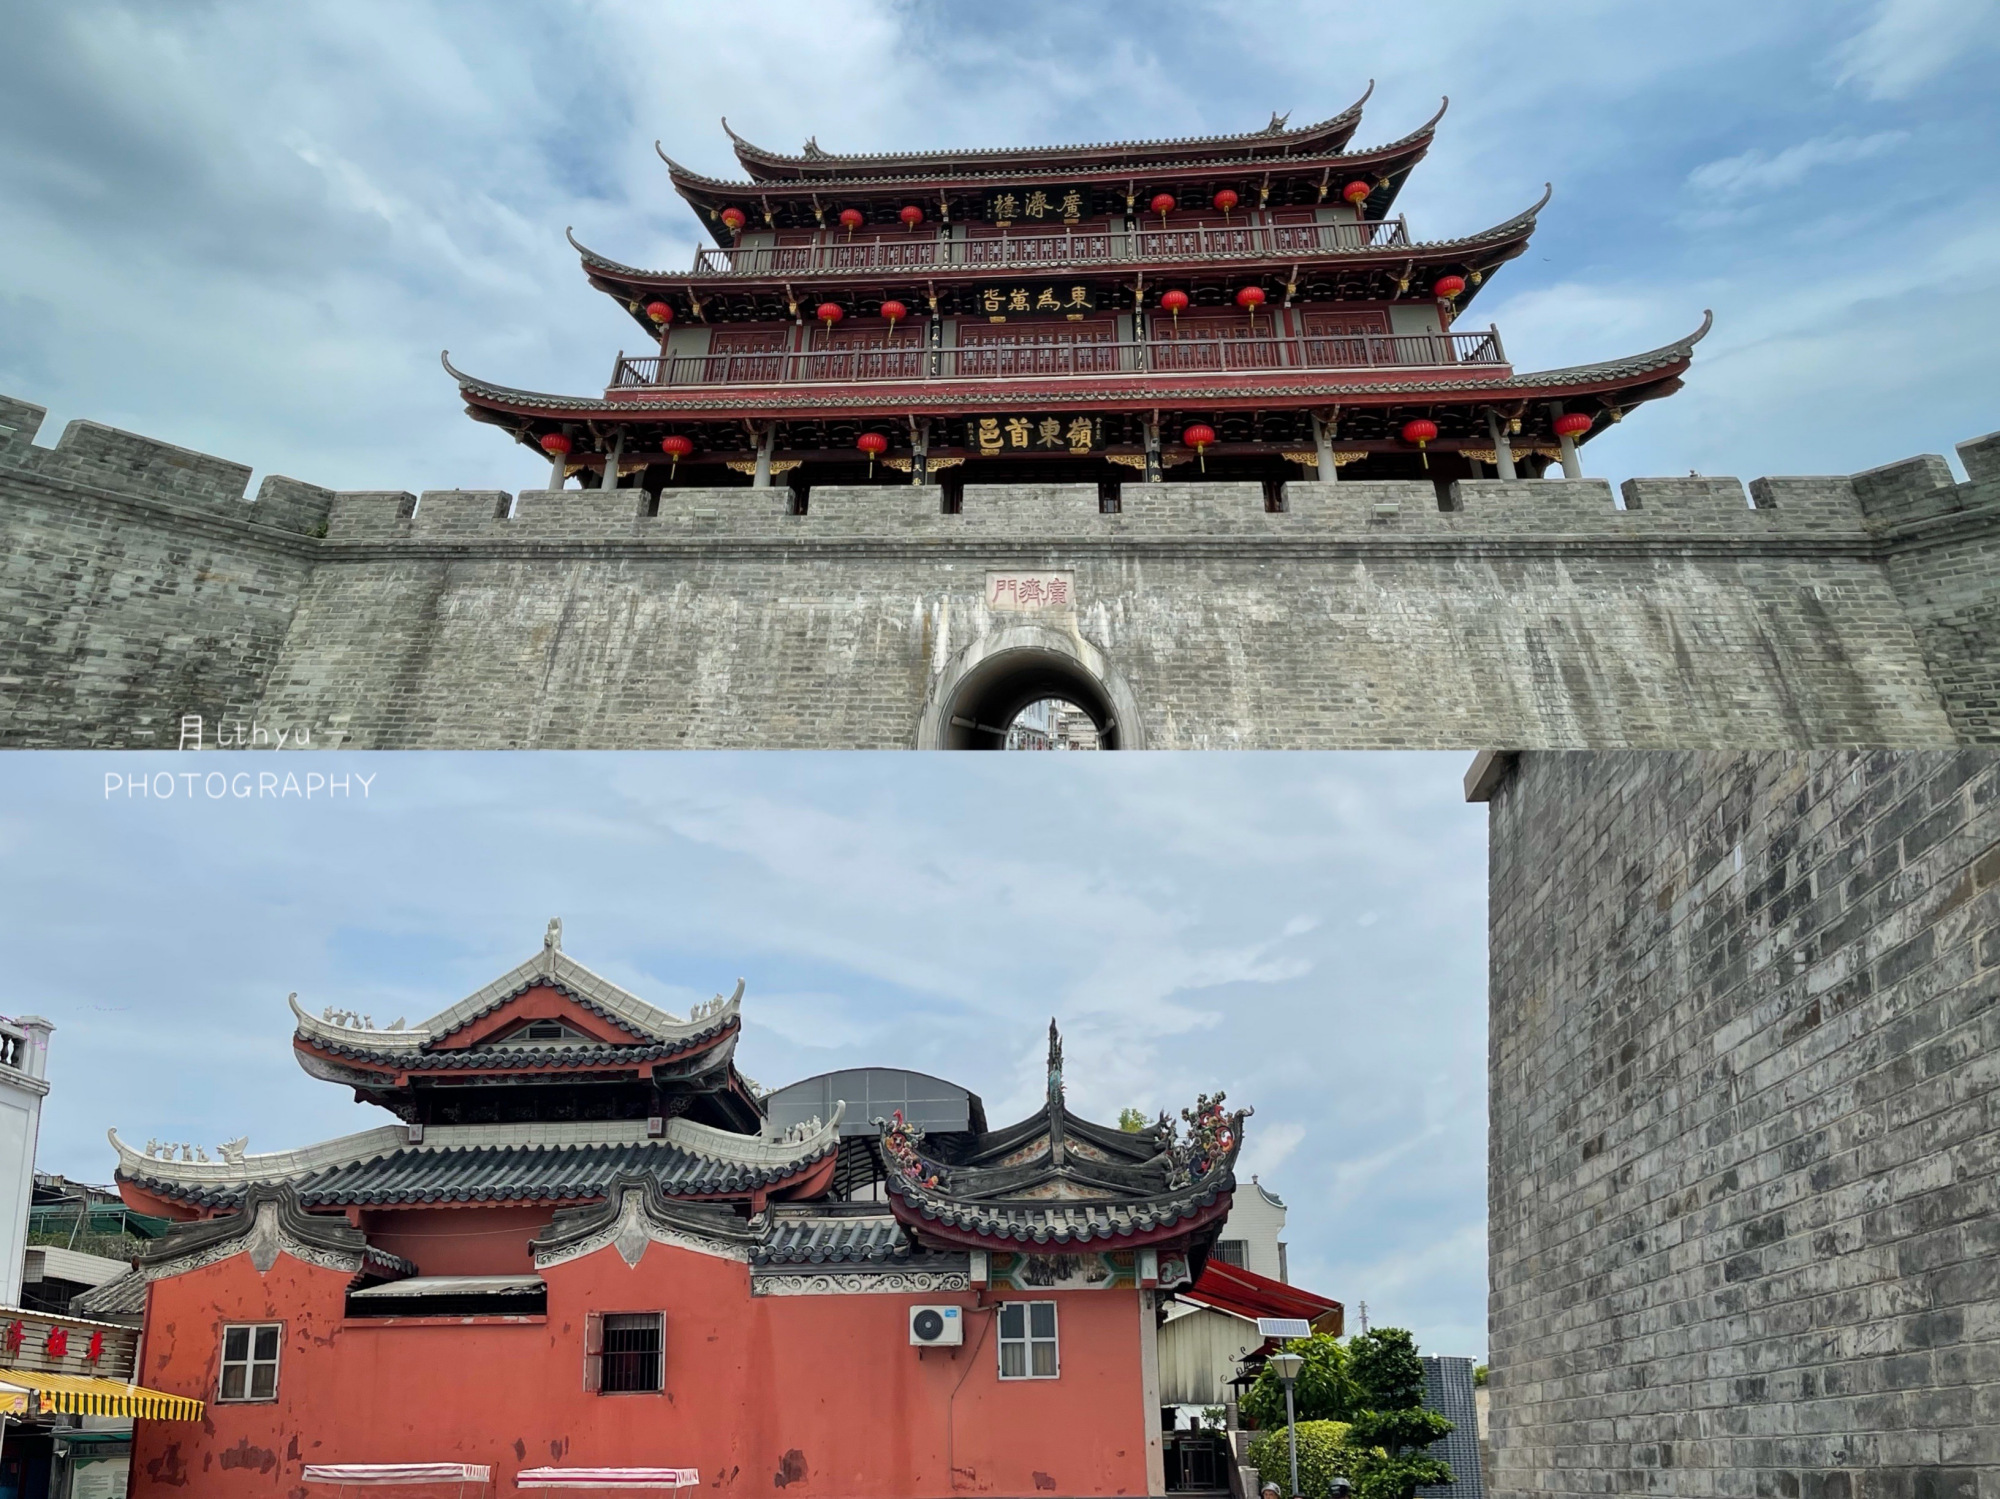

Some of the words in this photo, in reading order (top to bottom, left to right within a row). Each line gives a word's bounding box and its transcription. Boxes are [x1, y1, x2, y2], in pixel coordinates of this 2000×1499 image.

[979, 416, 1093, 448] 嶺東首邑
[992, 577, 1068, 606] 廣濟門
